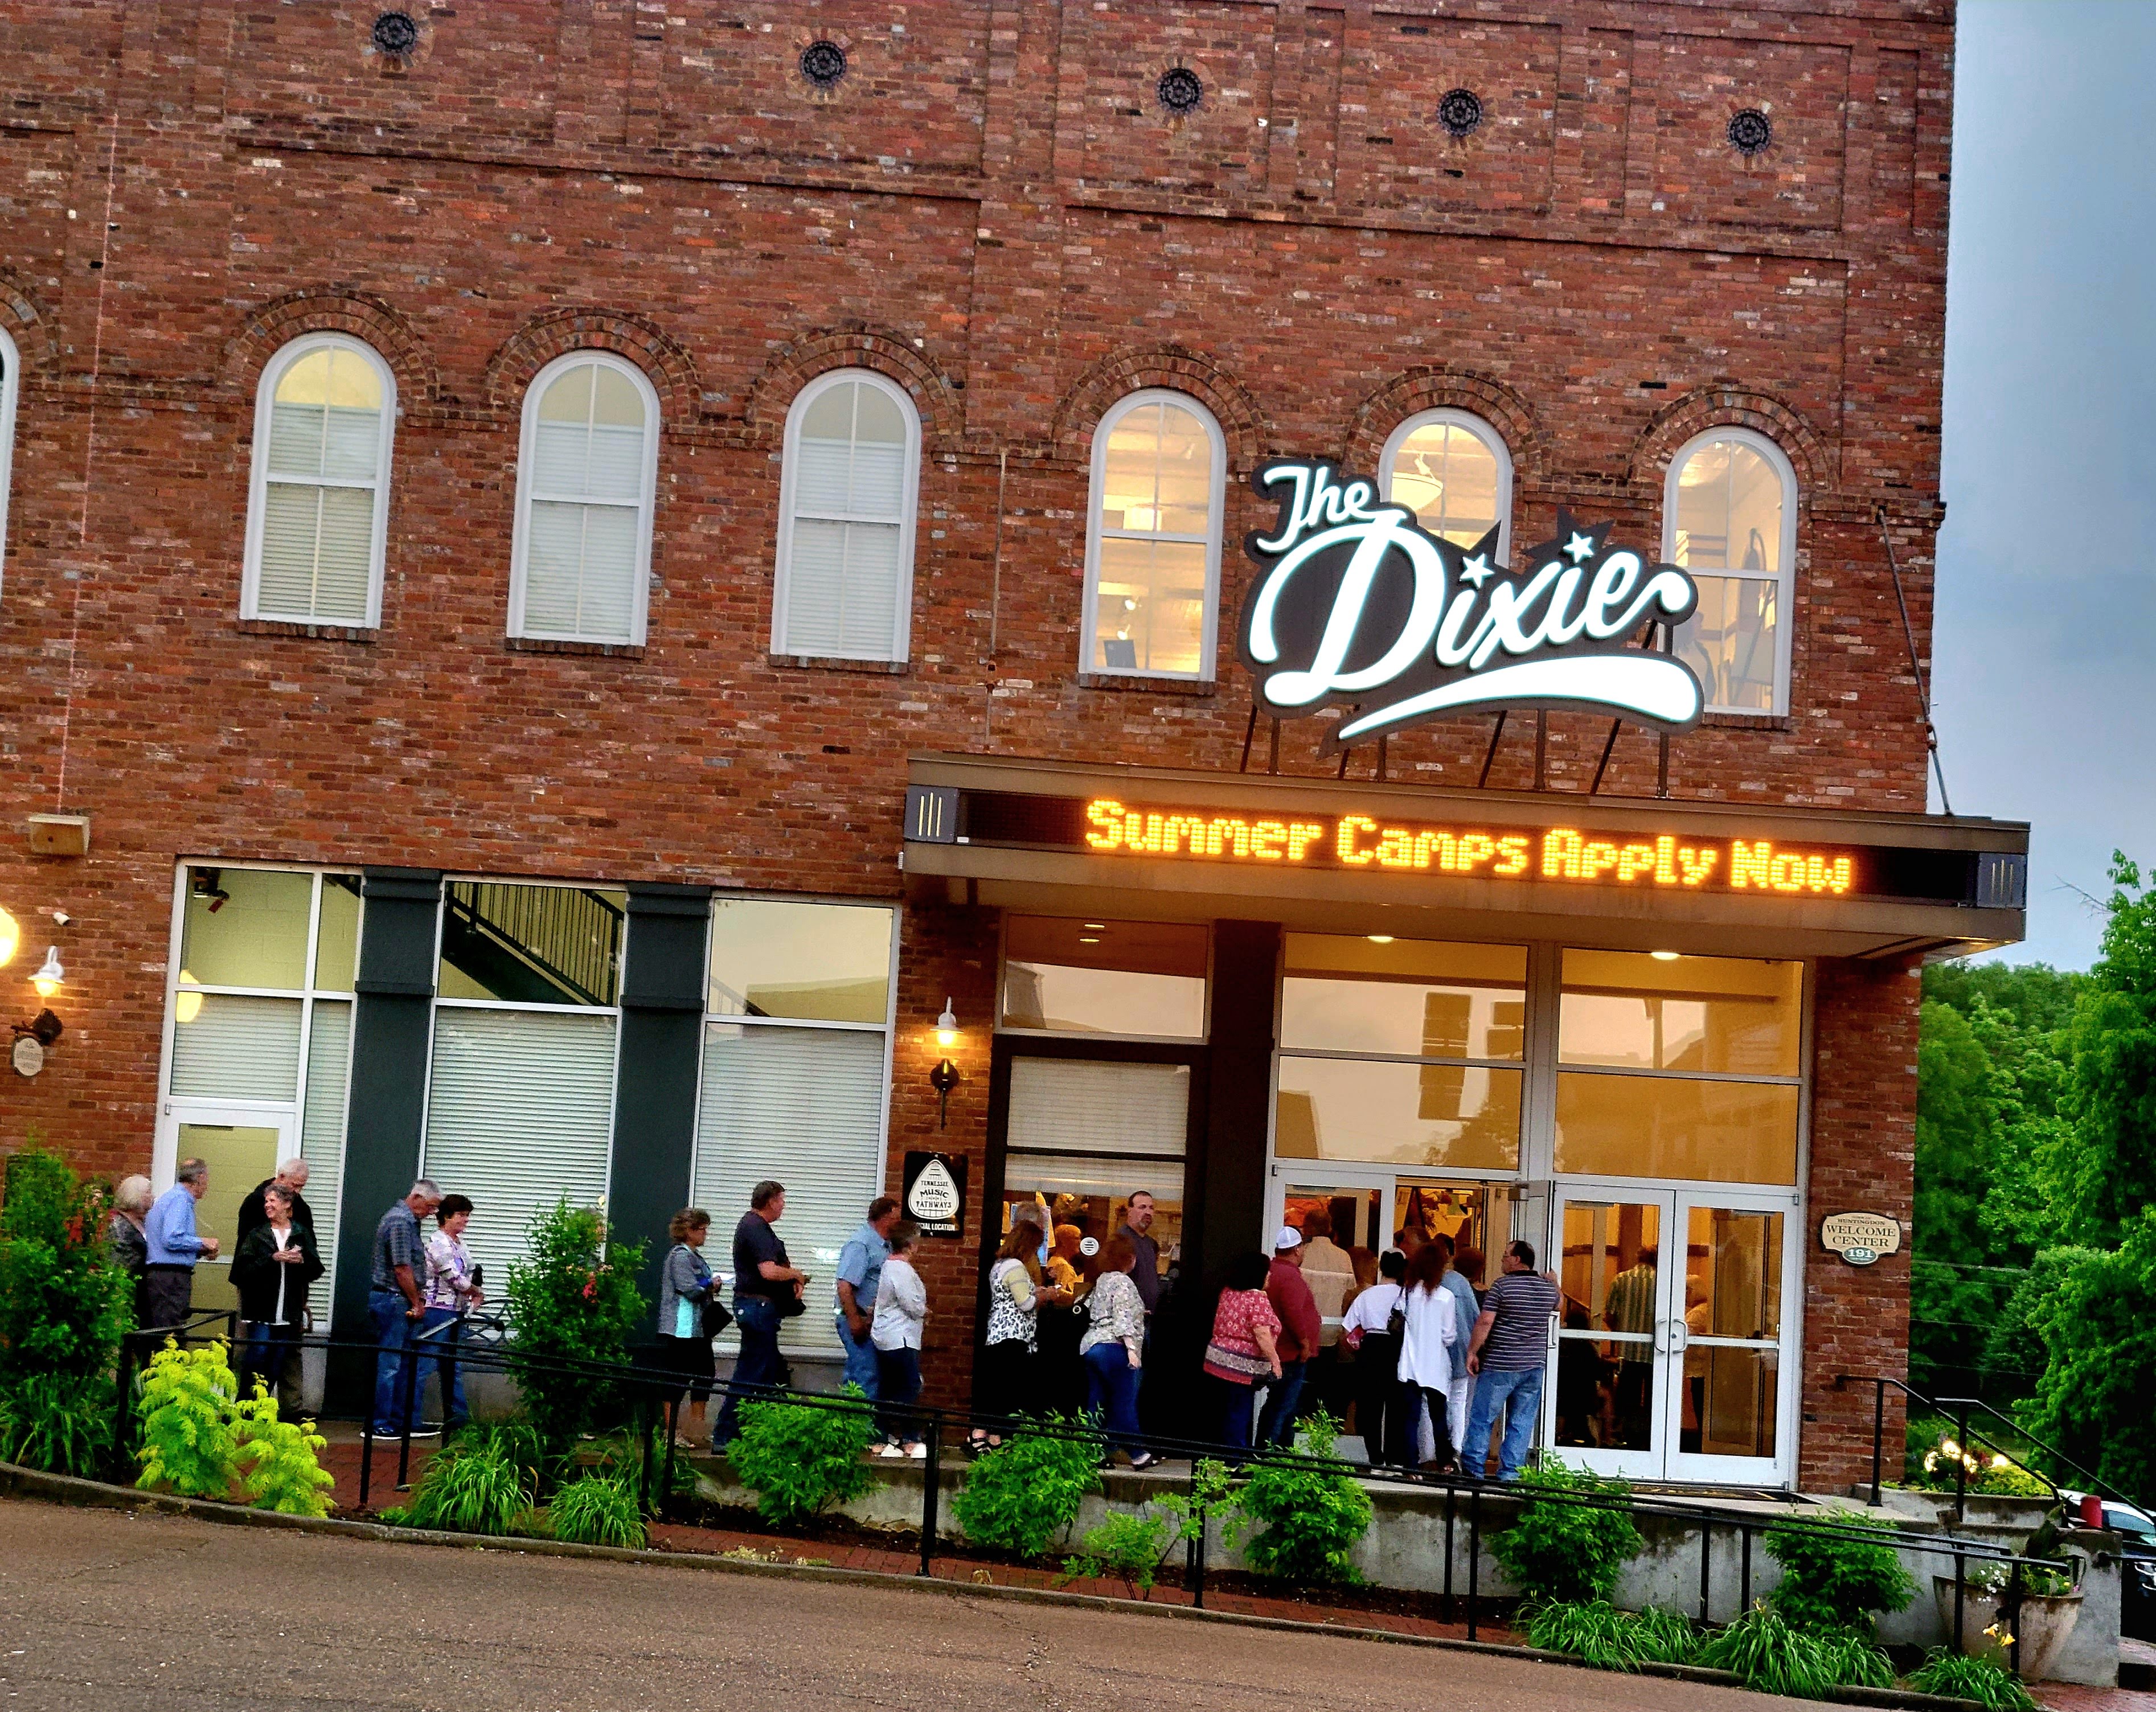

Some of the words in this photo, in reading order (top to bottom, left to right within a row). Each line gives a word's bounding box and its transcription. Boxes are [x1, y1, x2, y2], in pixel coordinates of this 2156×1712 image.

[1257, 465, 1408, 553] The
[1249, 517, 1691, 707] Dixie
[1085, 799, 1322, 860] Summer
[1337, 815, 1530, 873] Camps
[1542, 829, 1716, 885] Apply
[1730, 839, 1851, 894] Now
[920, 1189, 949, 1198] MUSIC
[1827, 1225, 1896, 1237] WELCOME
[1832, 1236, 1889, 1247] CENTER
